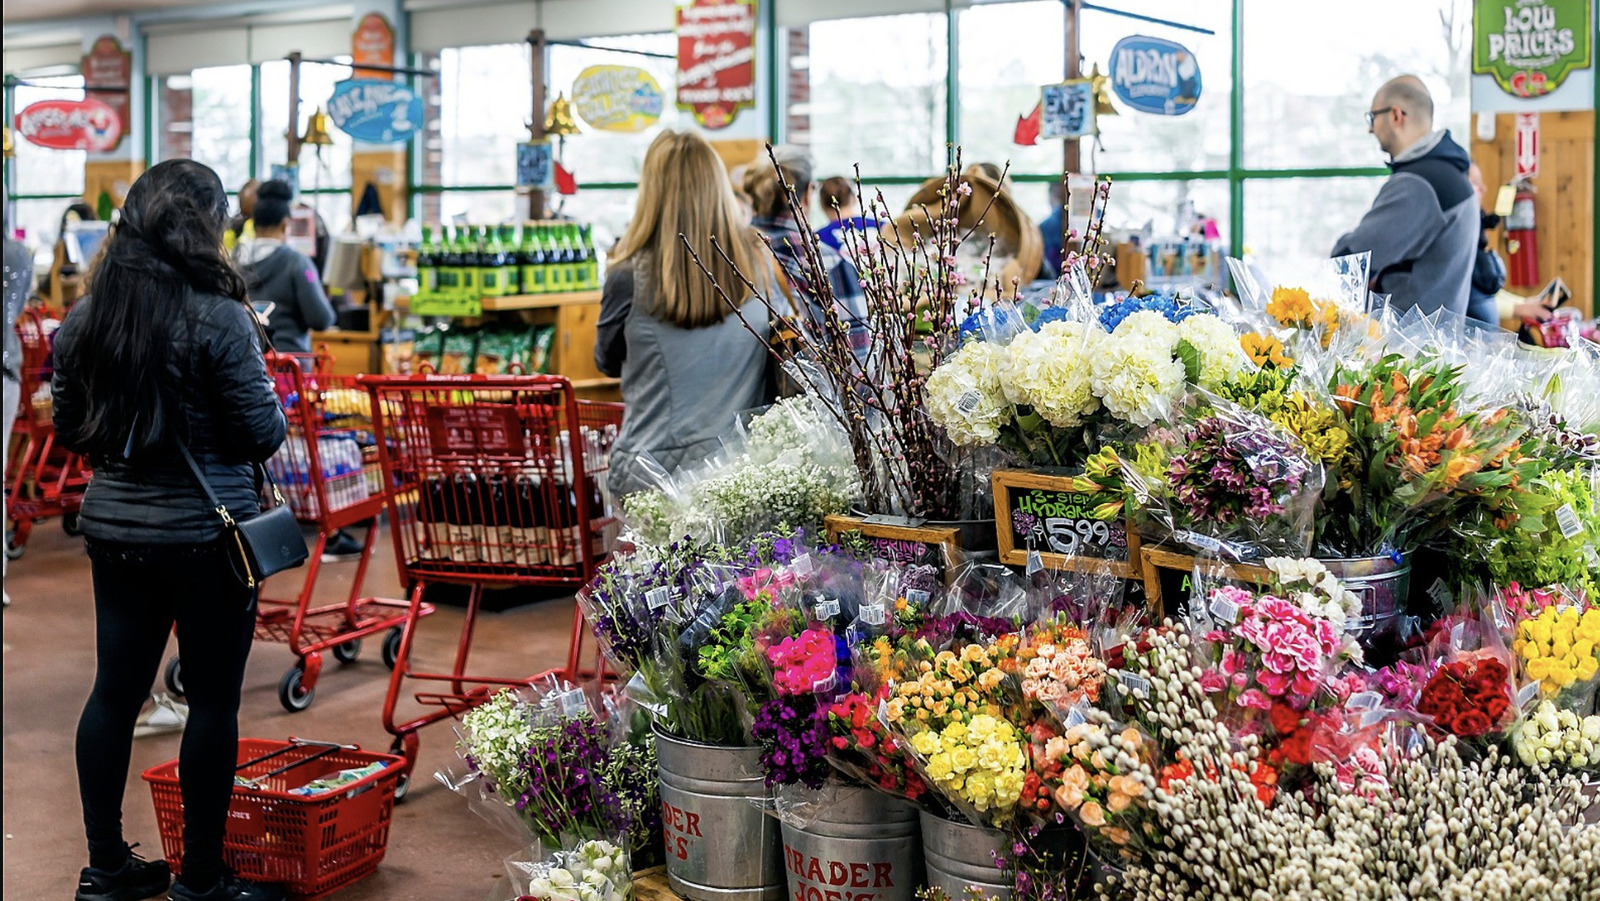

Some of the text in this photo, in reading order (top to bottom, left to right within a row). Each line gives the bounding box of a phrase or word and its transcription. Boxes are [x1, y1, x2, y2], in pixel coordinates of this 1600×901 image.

[1503, 4, 1556, 32] LOW
[1488, 28, 1575, 61] PRICES
[784, 844, 894, 888] TRADER
